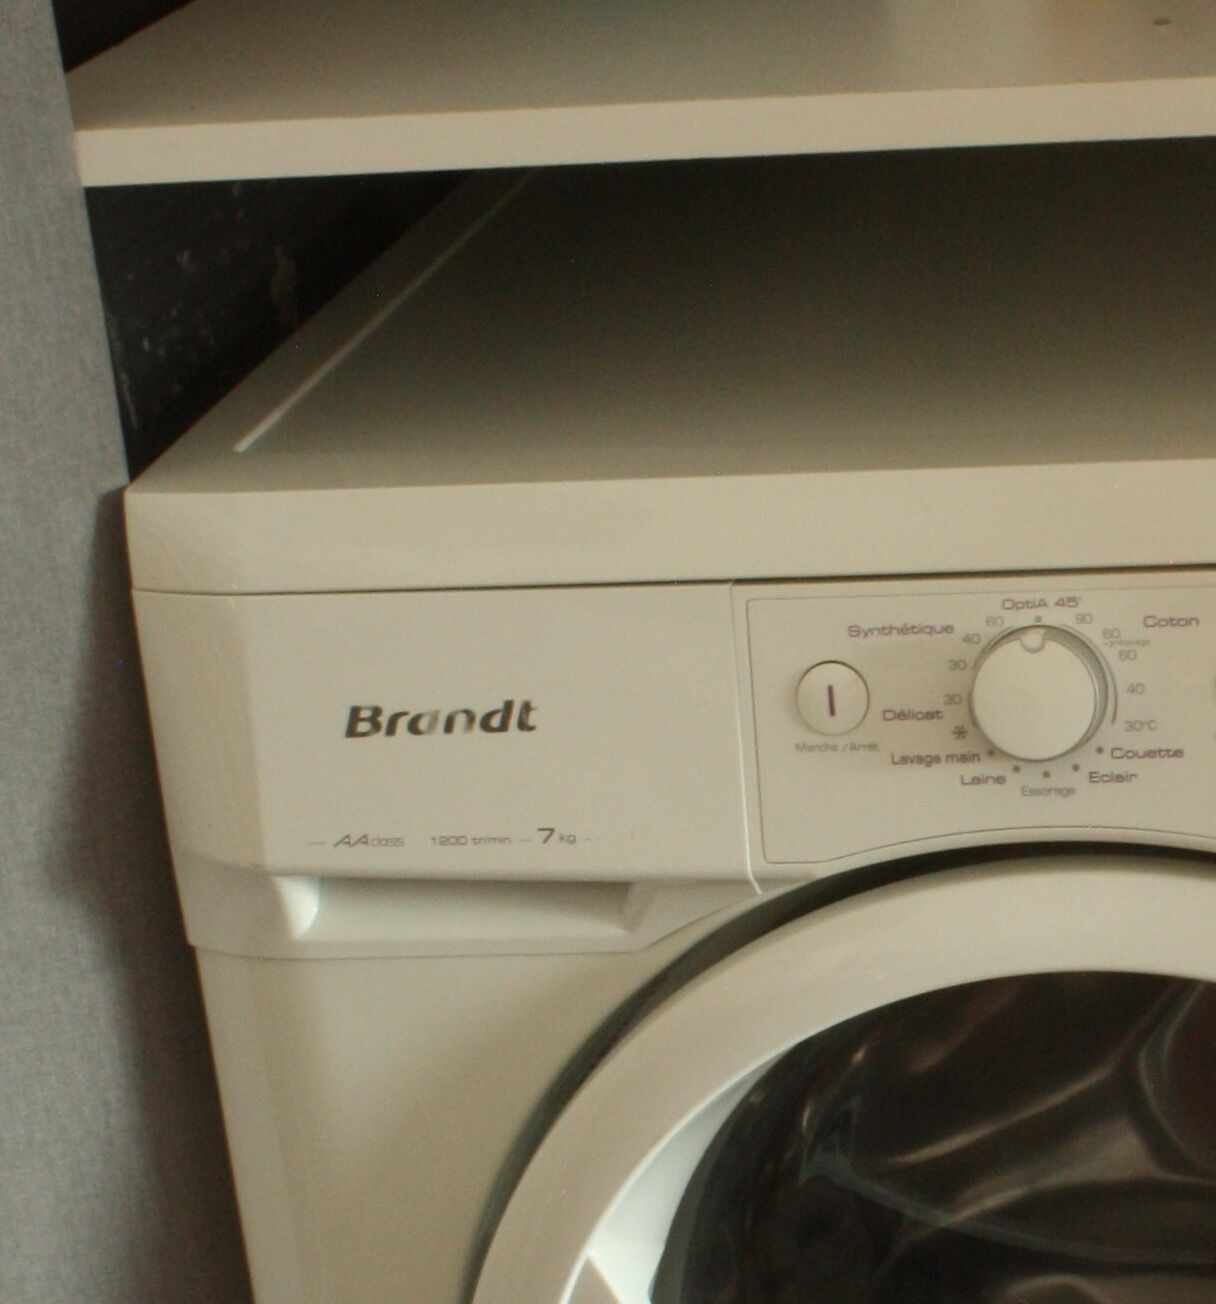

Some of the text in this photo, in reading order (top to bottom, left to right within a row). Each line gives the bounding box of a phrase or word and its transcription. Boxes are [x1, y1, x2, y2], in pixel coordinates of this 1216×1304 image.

[1002, 598, 1048, 610] OptiA
[1144, 615, 1200, 627] Coton
[848, 624, 954, 638] Synthétique
[962, 634, 981, 644] 40
[948, 660, 966, 670] 30
[1127, 683, 1145, 694] 40
[944, 694, 962, 705] 30
[344, 699, 540, 738] Brandt
[882, 708, 944, 720] Délicat
[891, 751, 980, 767] Lavage main
[1110, 747, 1184, 759] Couette
[961, 774, 1006, 785] Laine
[1089, 771, 1137, 784] Eclair
[1021, 785, 1076, 798] Essorage
[537, 828, 555, 844] 7
[558, 833, 576, 844] kg
